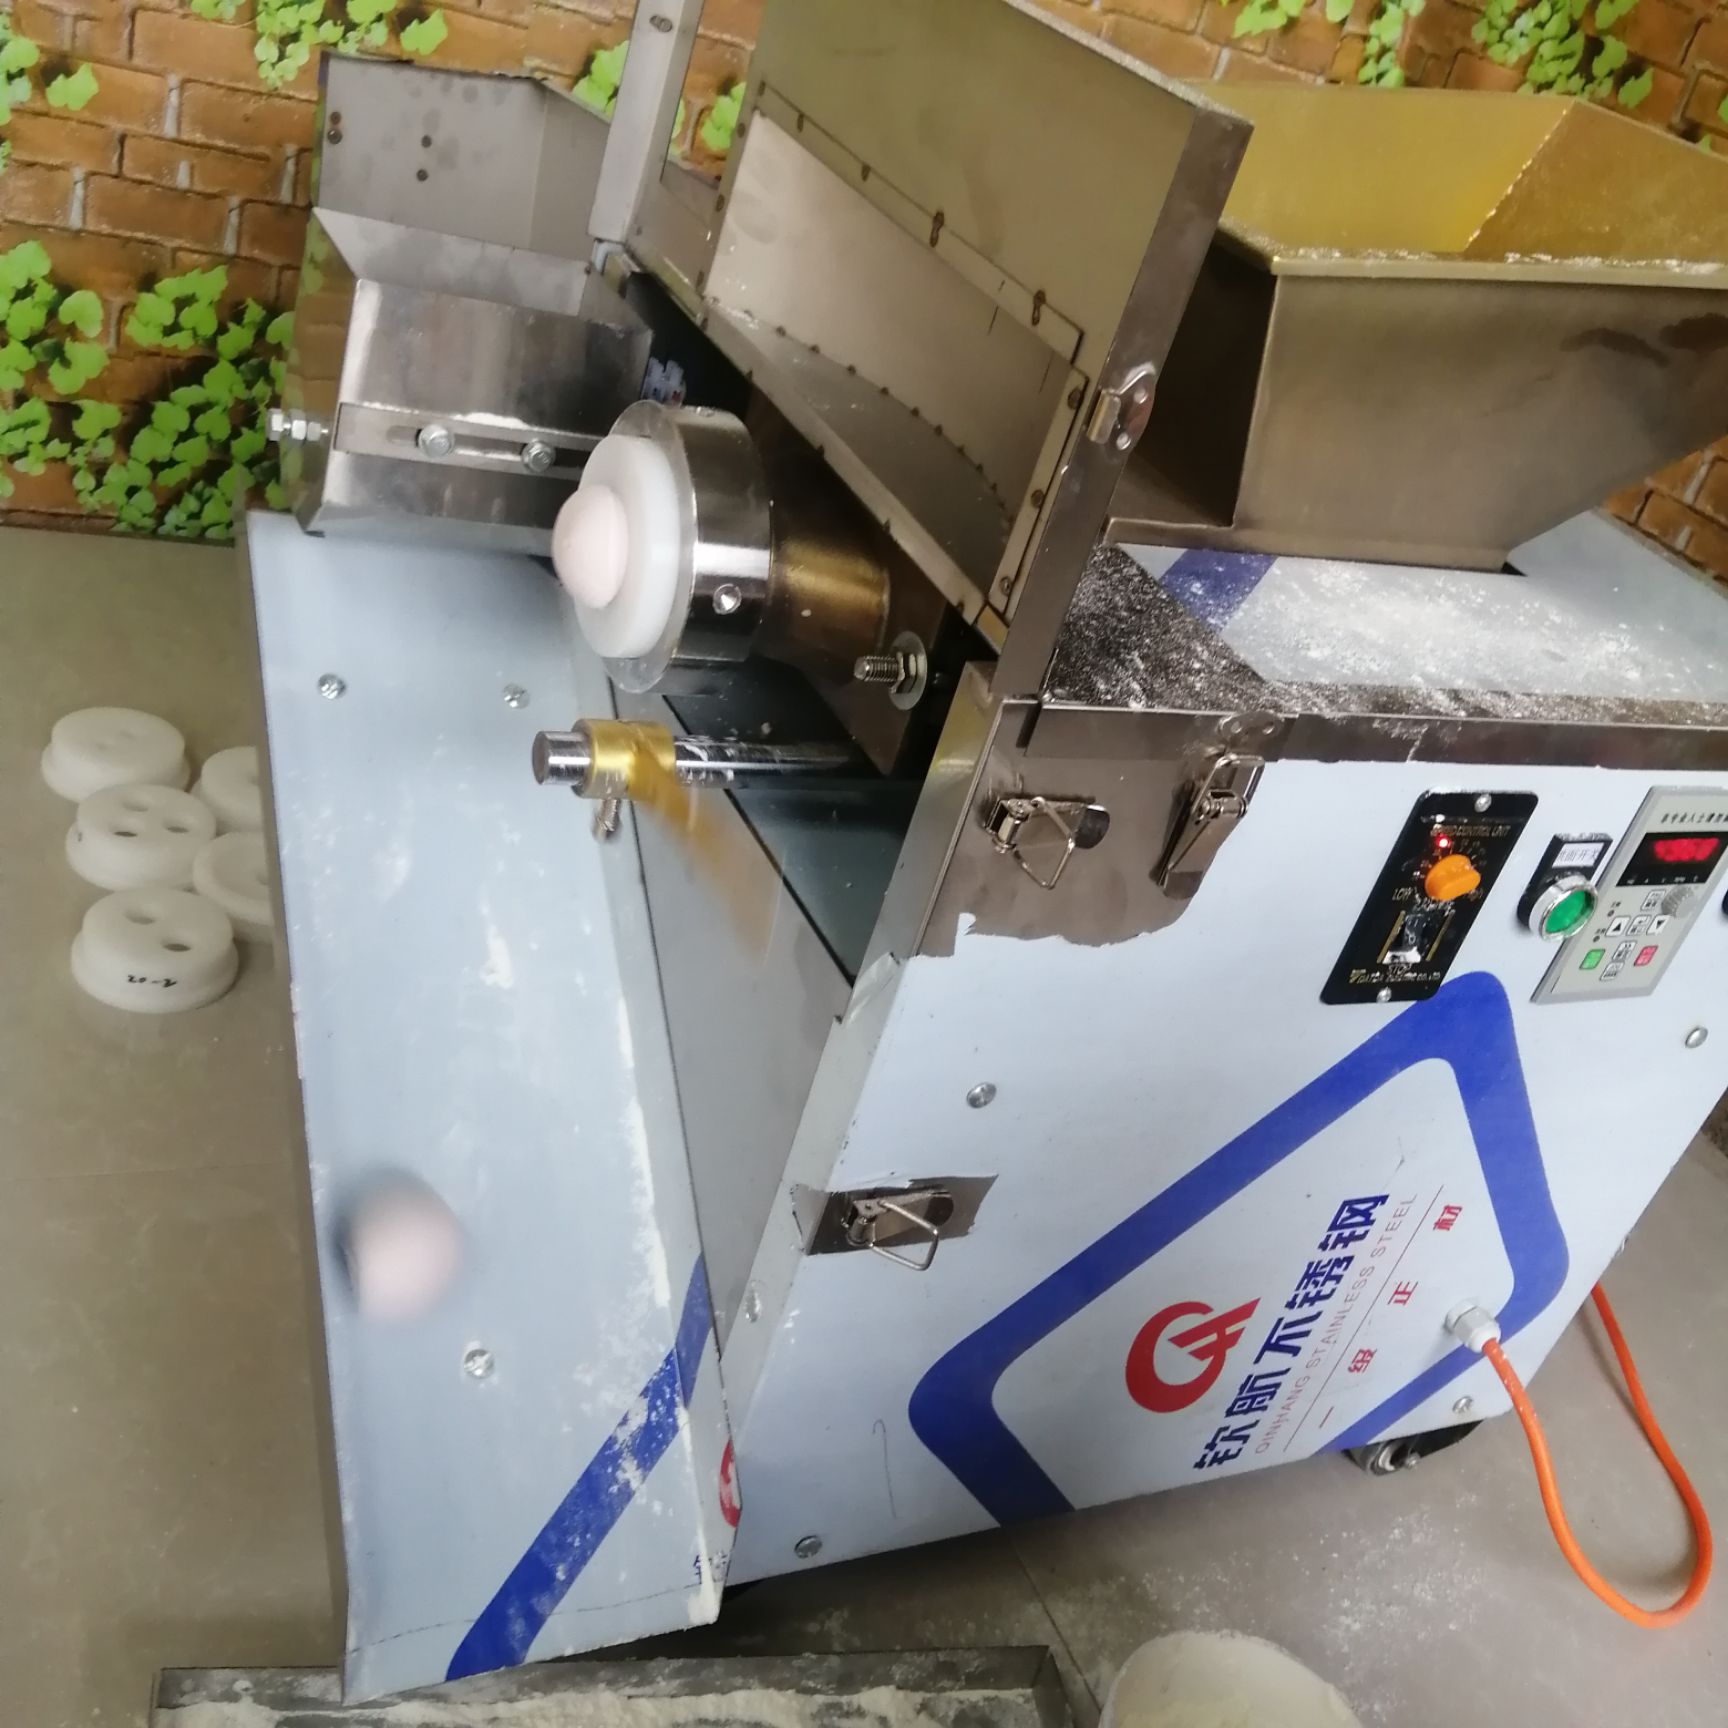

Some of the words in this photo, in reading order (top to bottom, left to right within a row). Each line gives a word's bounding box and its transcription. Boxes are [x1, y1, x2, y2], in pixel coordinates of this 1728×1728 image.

[1193, 1194, 1389, 1469] 钦航不锈钢
[1254, 1375, 1311, 1455] QINHANG
[1305, 1265, 1376, 1369] STAINLESS
[1370, 1193, 1418, 1259] STEEL
